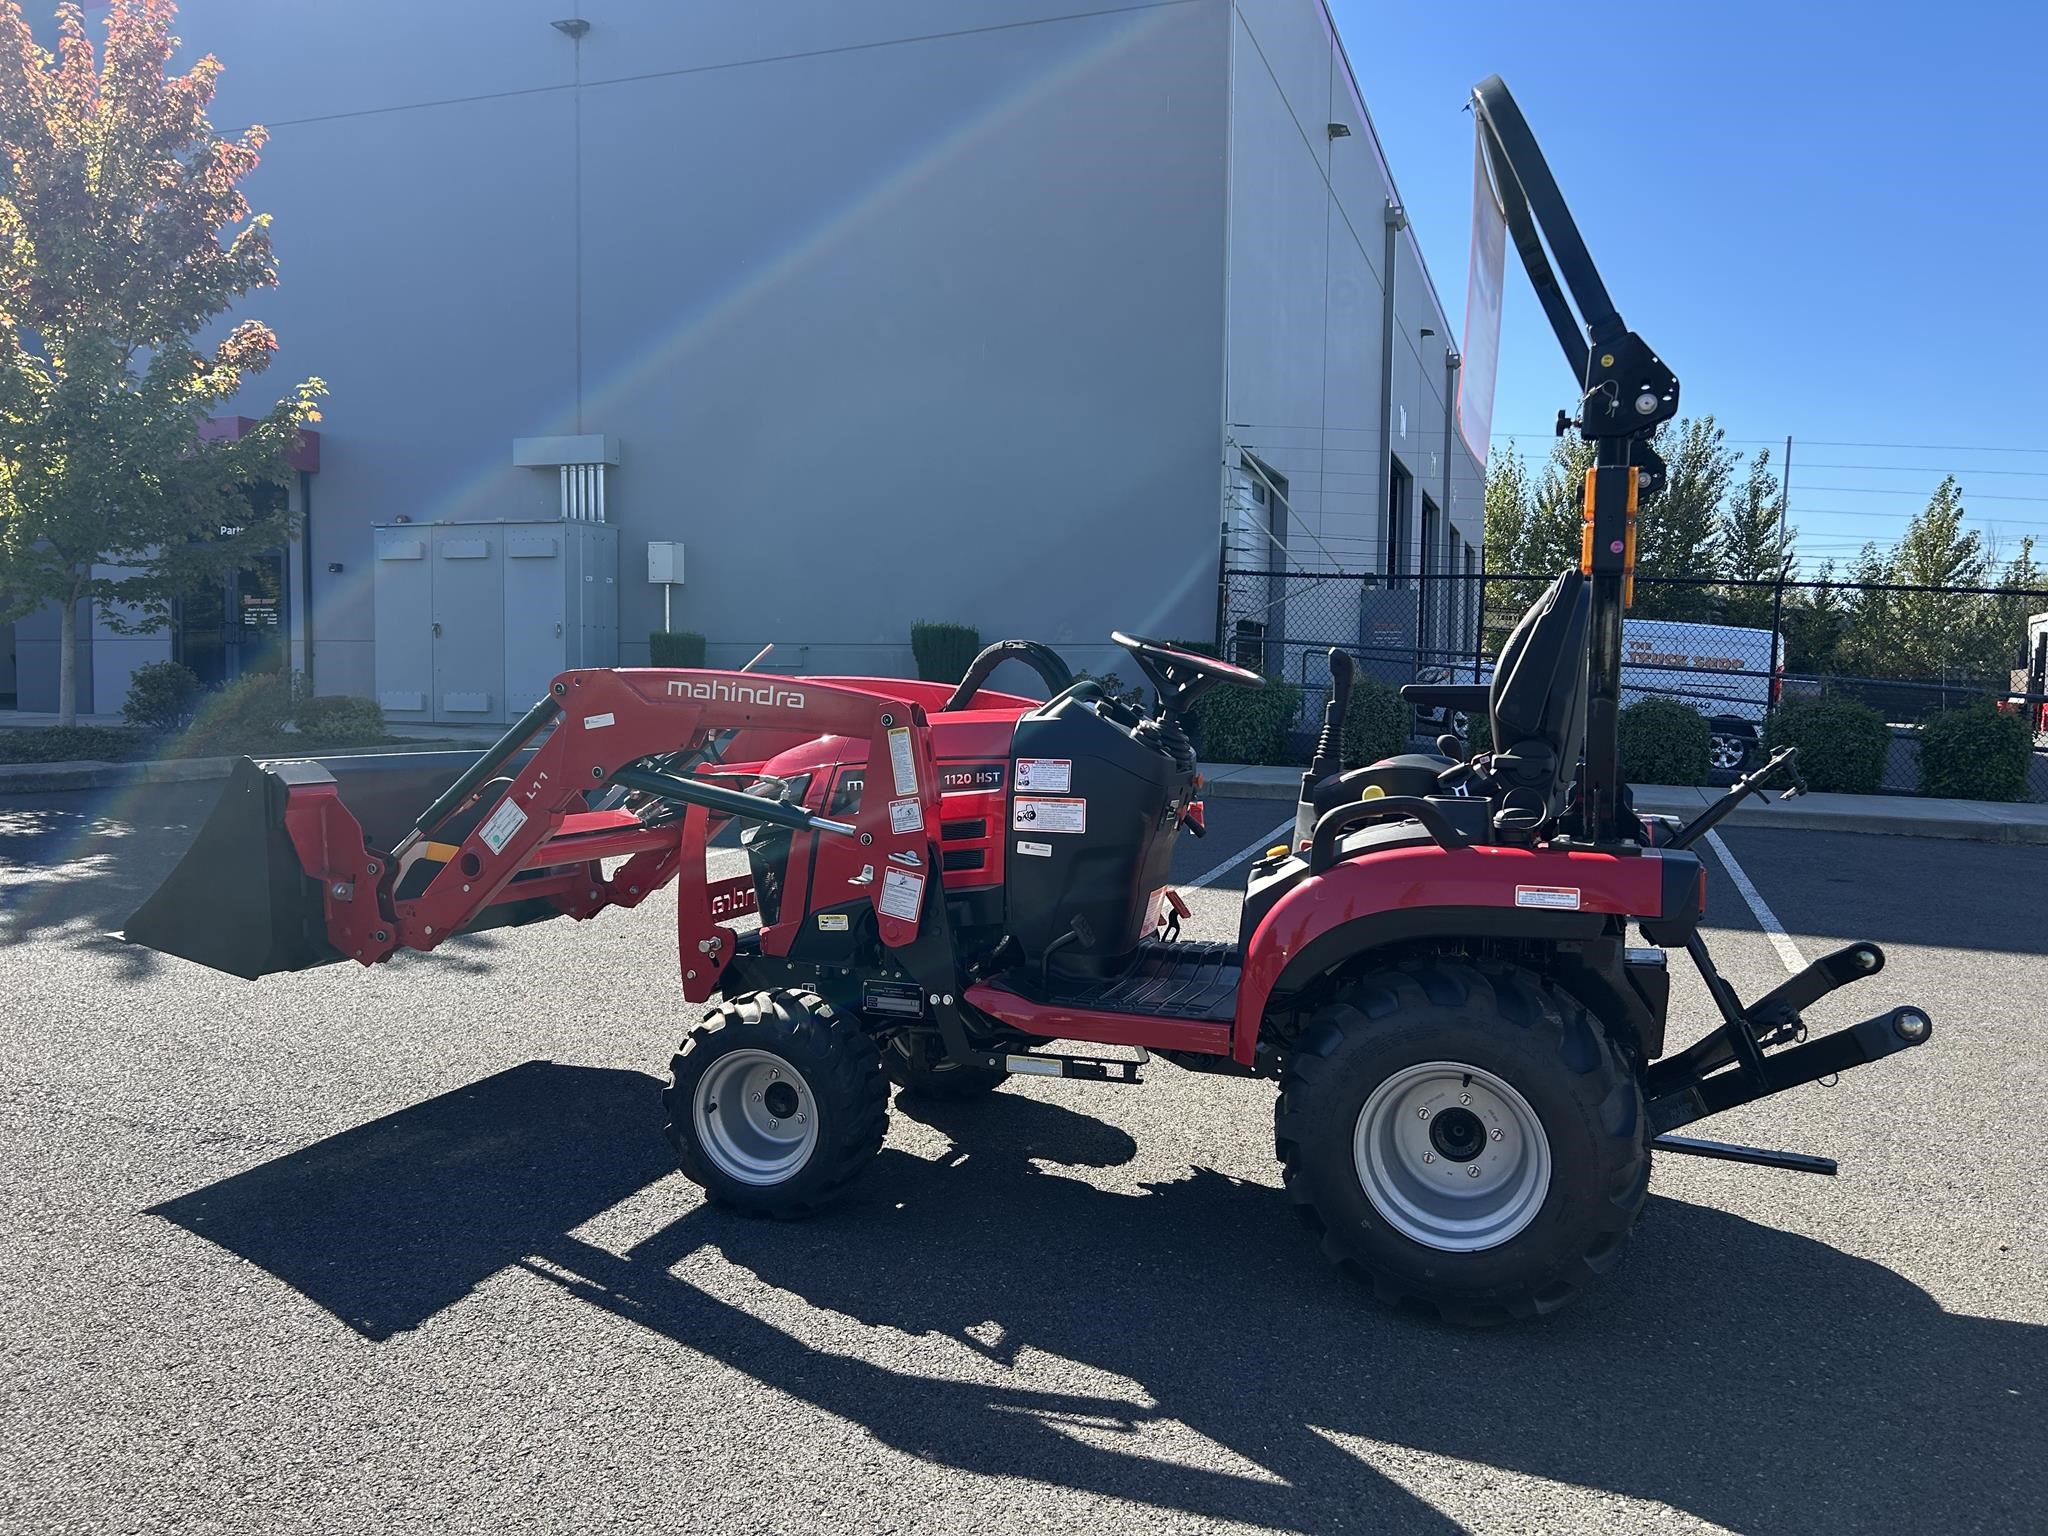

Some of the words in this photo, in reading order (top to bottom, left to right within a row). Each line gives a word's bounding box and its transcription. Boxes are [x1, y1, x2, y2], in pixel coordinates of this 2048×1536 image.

[667, 680, 805, 709] mahindra
[944, 773, 972, 785] 1120
[976, 772, 1001, 783] HST
